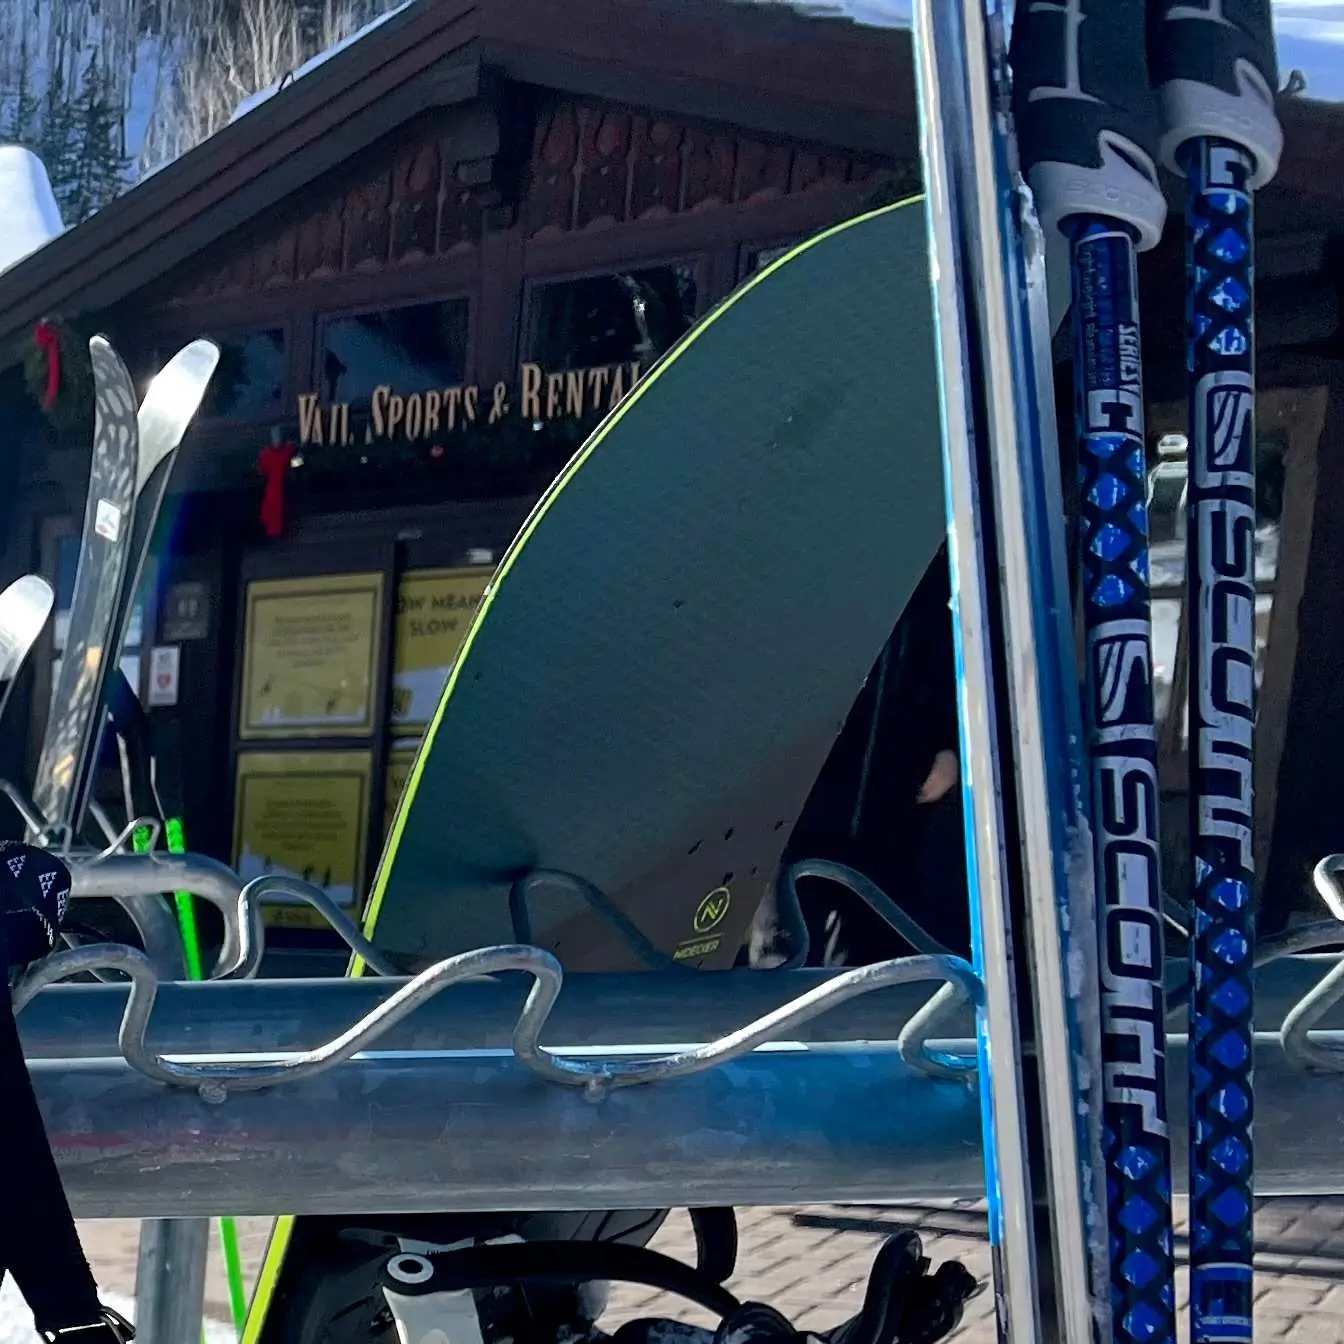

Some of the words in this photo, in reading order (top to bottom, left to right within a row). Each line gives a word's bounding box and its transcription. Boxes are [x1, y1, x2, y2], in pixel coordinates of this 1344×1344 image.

[297, 393, 355, 447] VAIL
[367, 384, 479, 446] SPORTS
[1117, 323, 1141, 383] SERIES
[1197, 503, 1256, 868] SCOTT
[1096, 757, 1171, 1141] SCOTT
